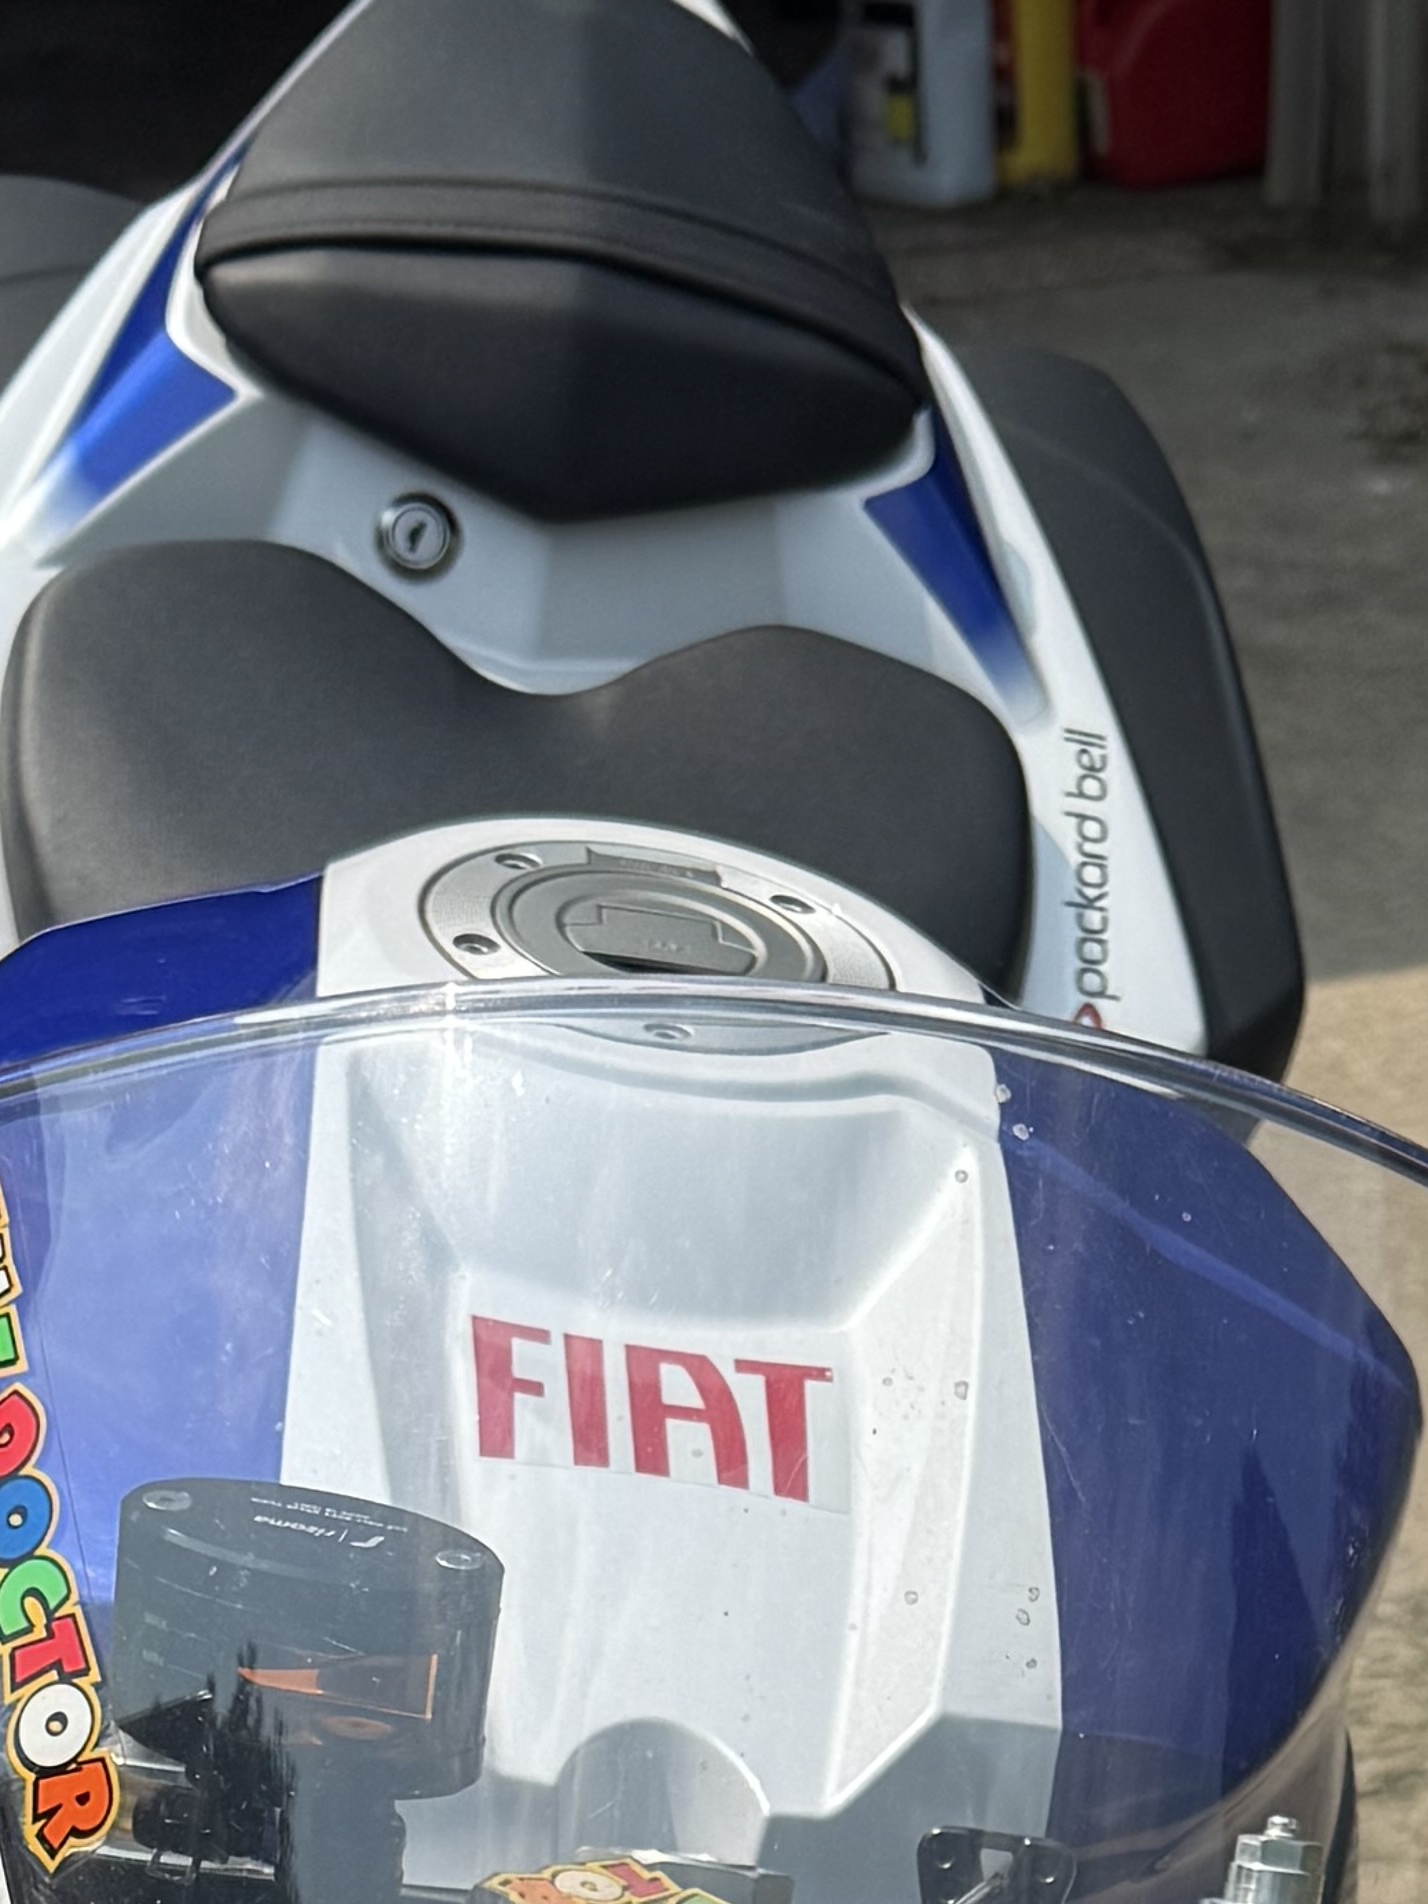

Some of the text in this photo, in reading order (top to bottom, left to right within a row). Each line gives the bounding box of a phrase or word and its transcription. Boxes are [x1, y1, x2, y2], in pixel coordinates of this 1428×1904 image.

[1062, 727, 1121, 1002] packard bell
[470, 1314, 834, 1503] FIAT
